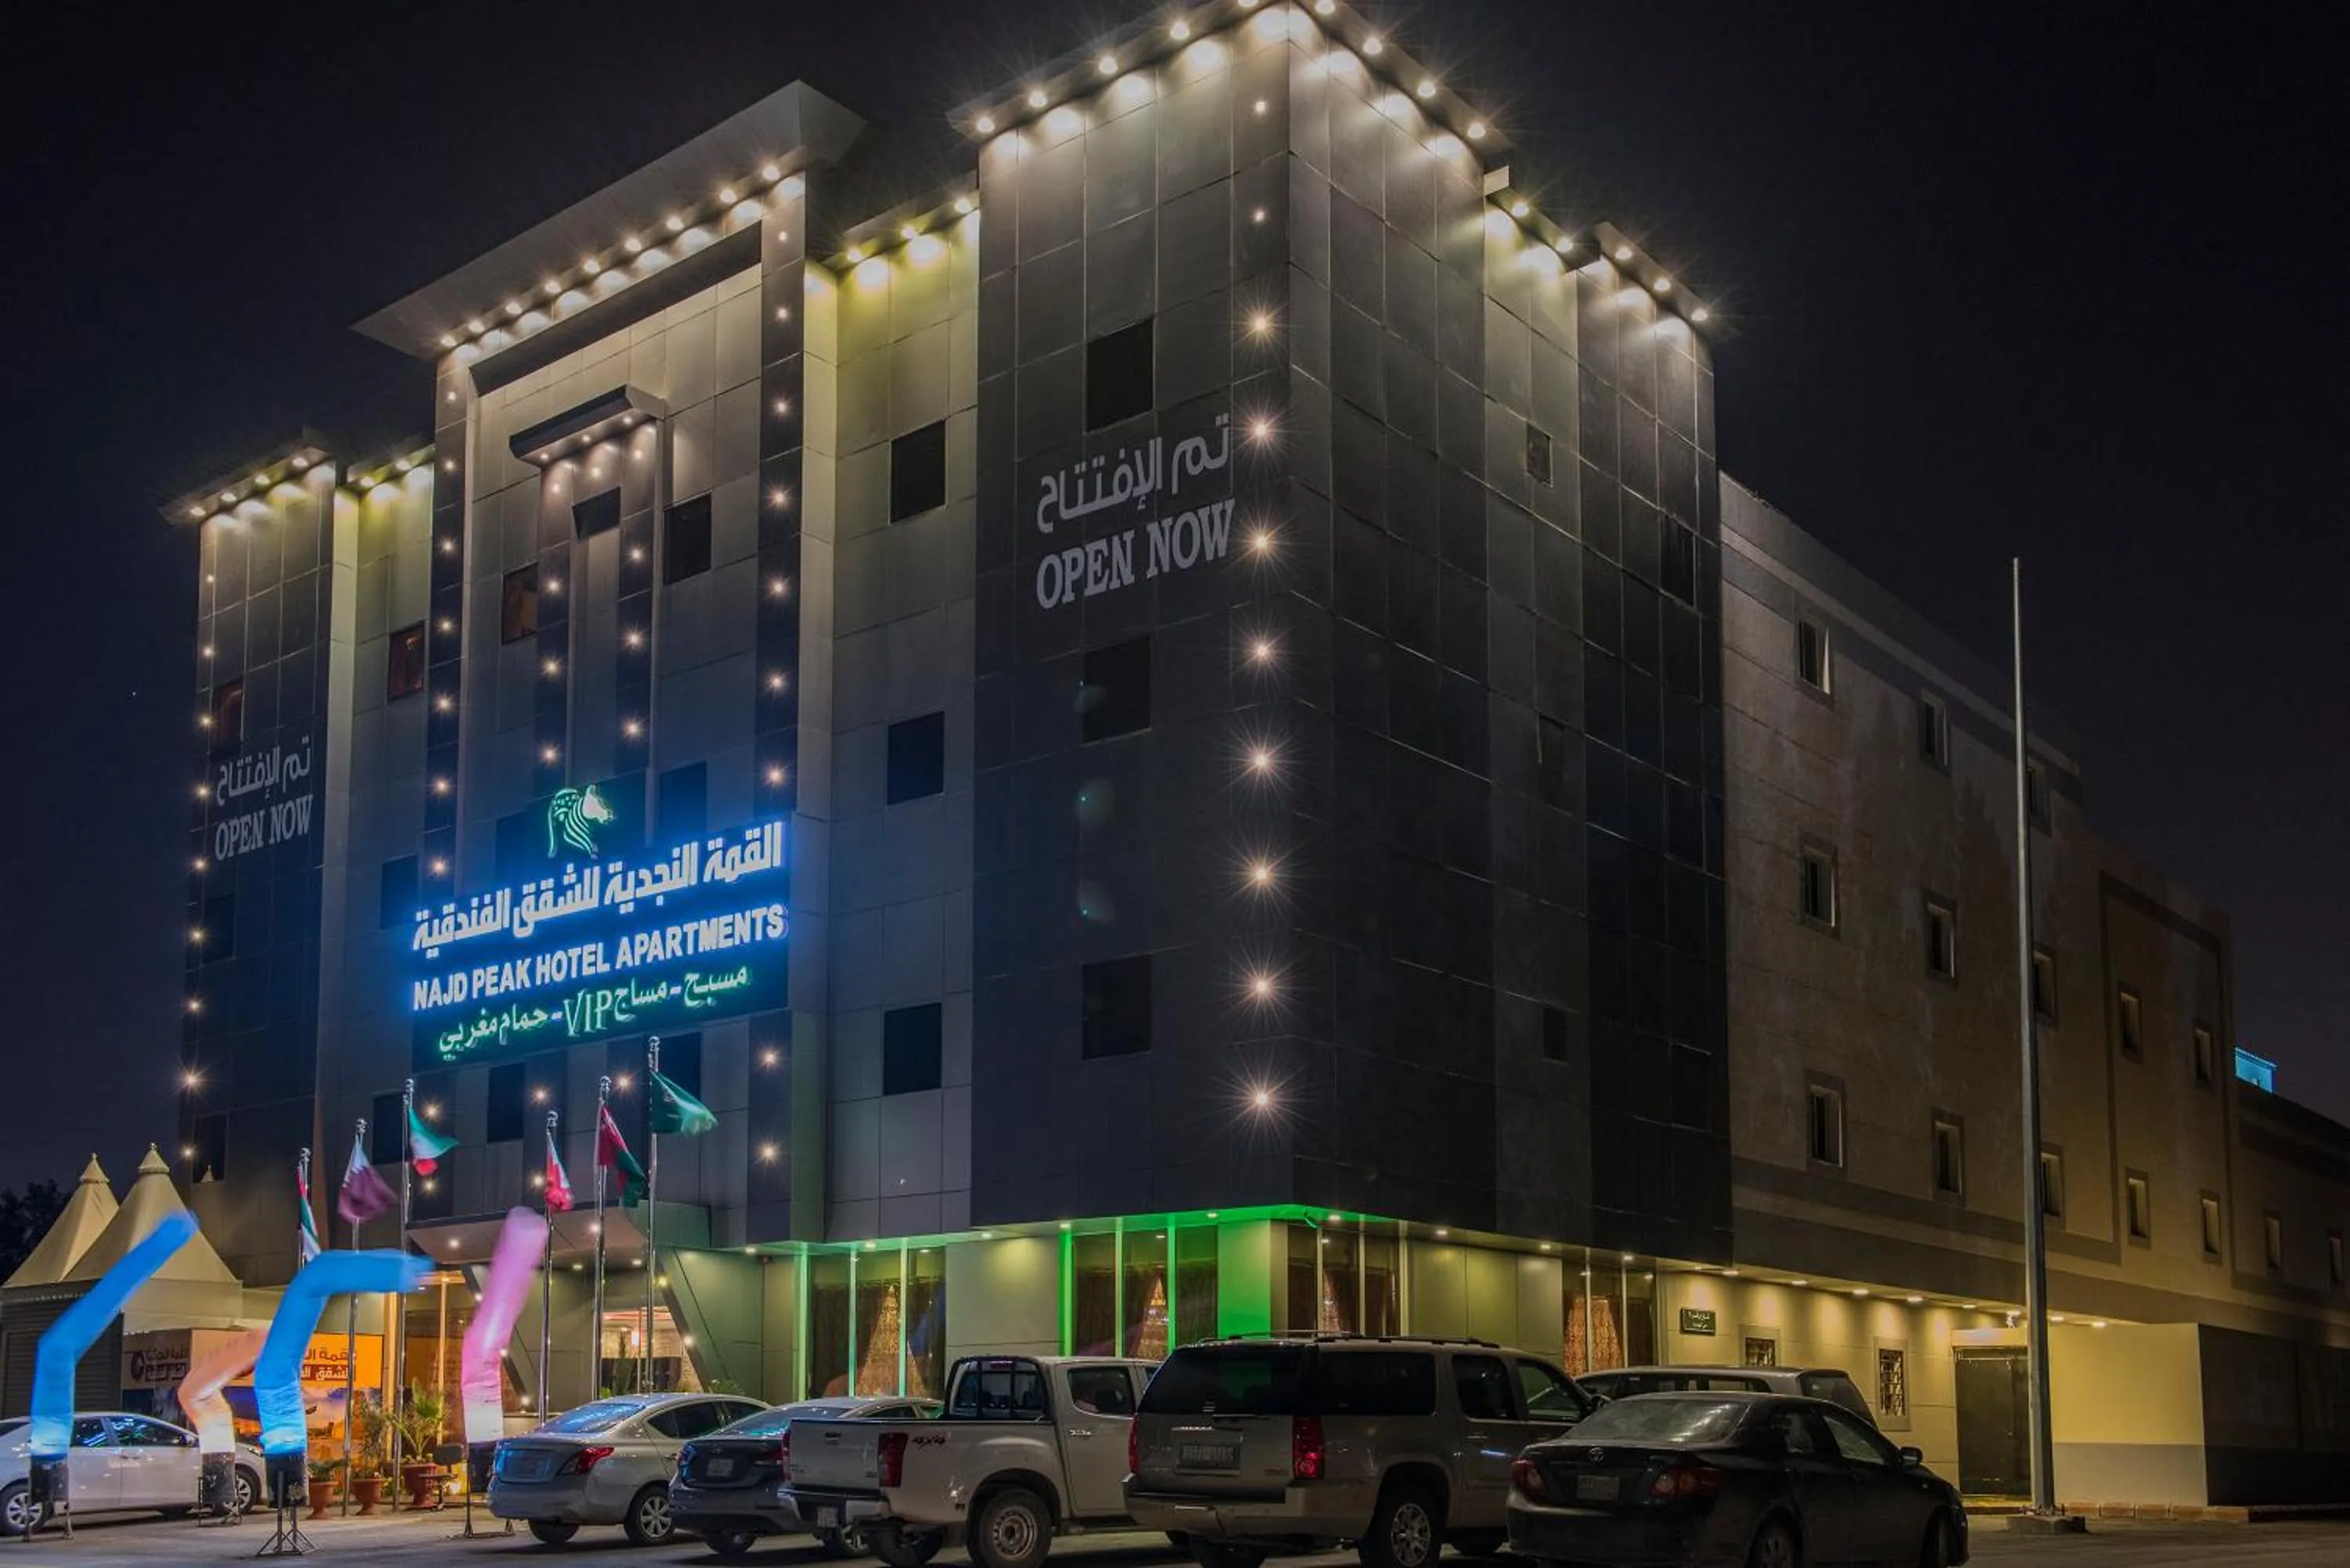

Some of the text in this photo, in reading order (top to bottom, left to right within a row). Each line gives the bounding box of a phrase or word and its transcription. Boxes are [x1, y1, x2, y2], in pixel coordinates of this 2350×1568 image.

[1036, 413, 1230, 534] تم الإفتتاح
[1036, 498, 1236, 609] OPEN NOW
[283, 733, 311, 793] تم
[215, 793, 314, 861] OPEN NOW
[413, 821, 783, 959] القمة النجدية للشقق الفندقية
[412, 903, 786, 1011] NAJD PEAK HOTEL APARTMENTS
[562, 988, 613, 1038] VIP
